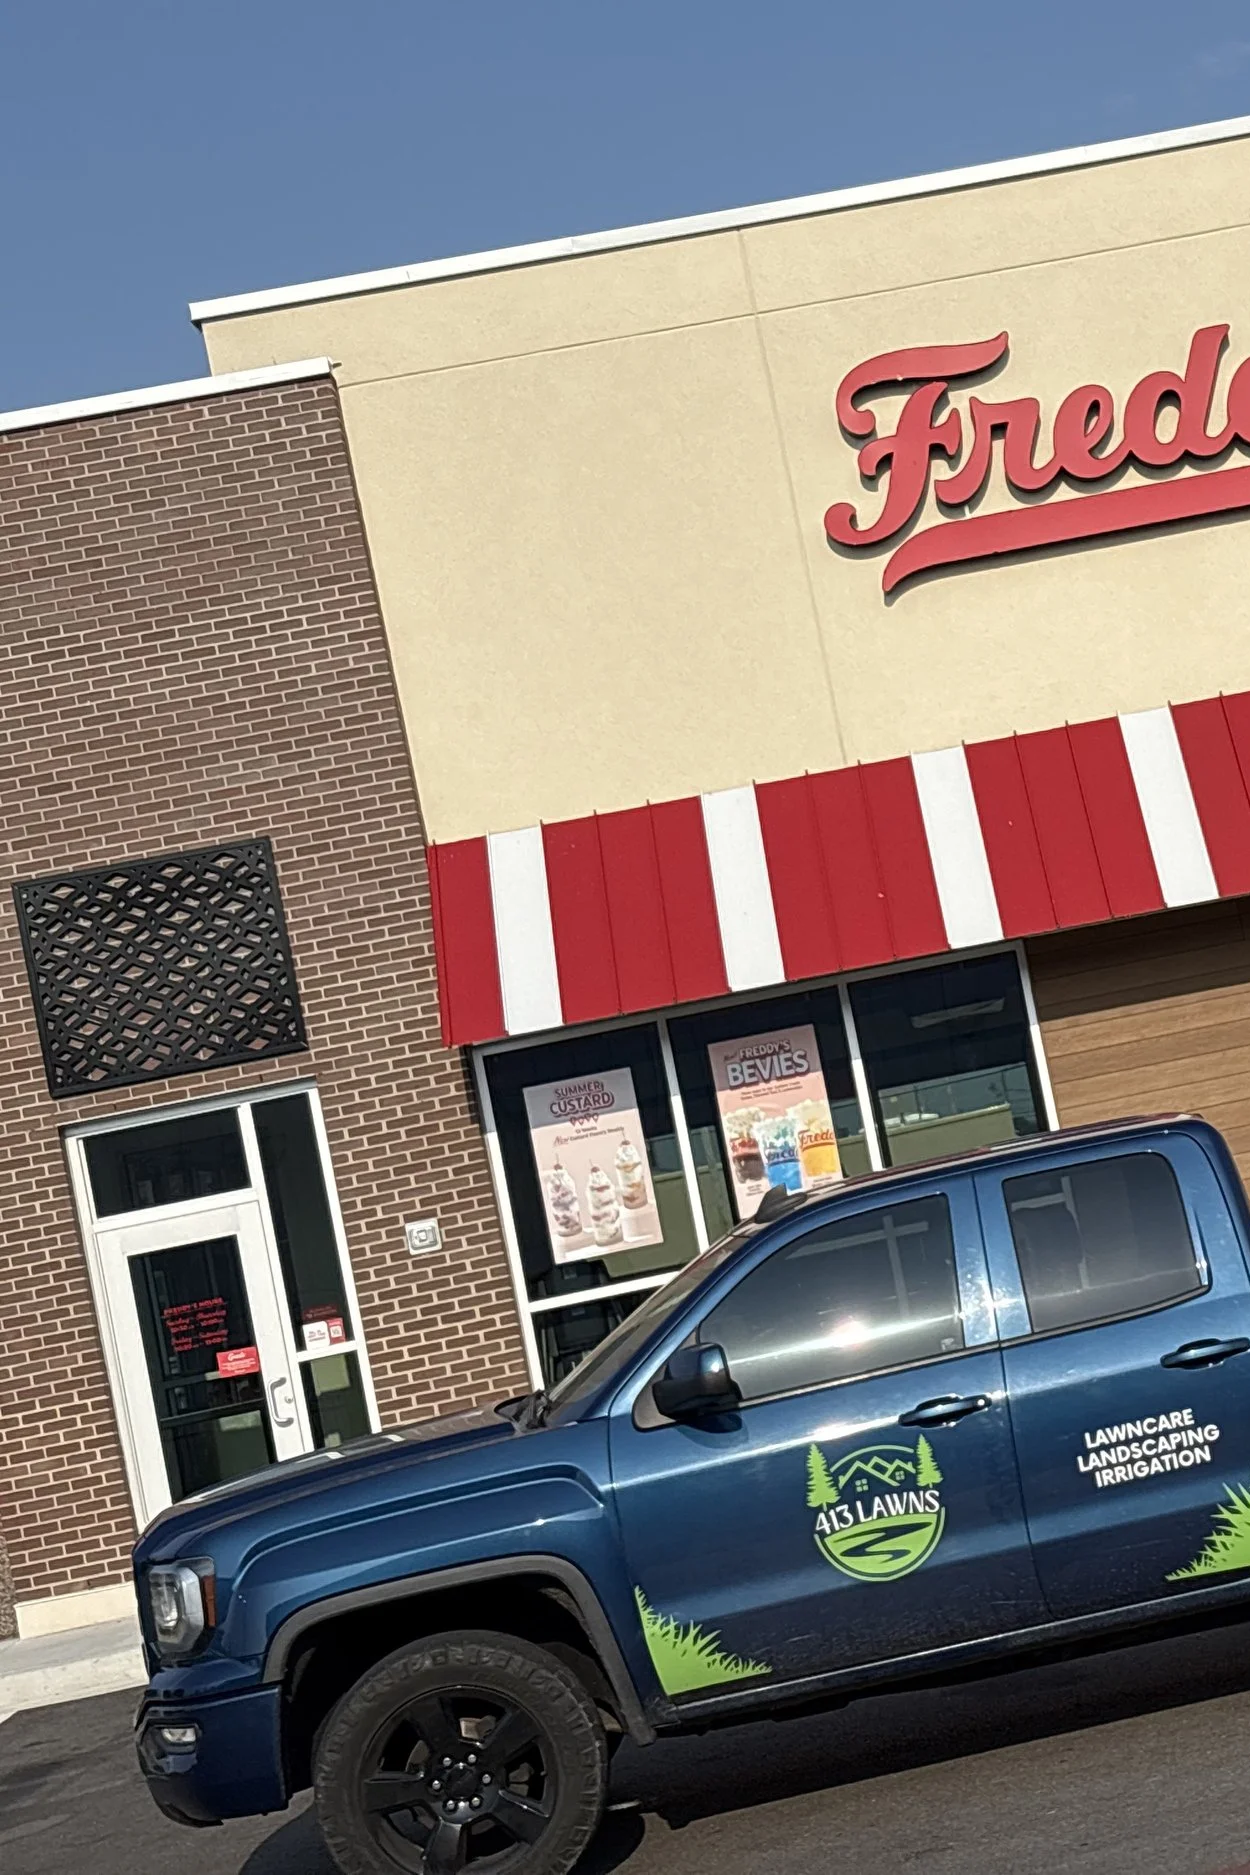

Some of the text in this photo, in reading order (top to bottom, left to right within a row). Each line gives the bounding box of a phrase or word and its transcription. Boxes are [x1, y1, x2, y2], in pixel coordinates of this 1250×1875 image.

[727, 1050, 809, 1088] BEVIES
[740, 1039, 791, 1060] FREDDY'S
[550, 1092, 614, 1116] CUSTARD
[555, 1081, 604, 1098] SUMMER
[1077, 1424, 1220, 1472] LANDSCAPING
[1084, 1408, 1195, 1449] LAWNCARE
[1094, 1445, 1212, 1488] IRRIGATION
[815, 1490, 940, 1534] 413 LAWNS
